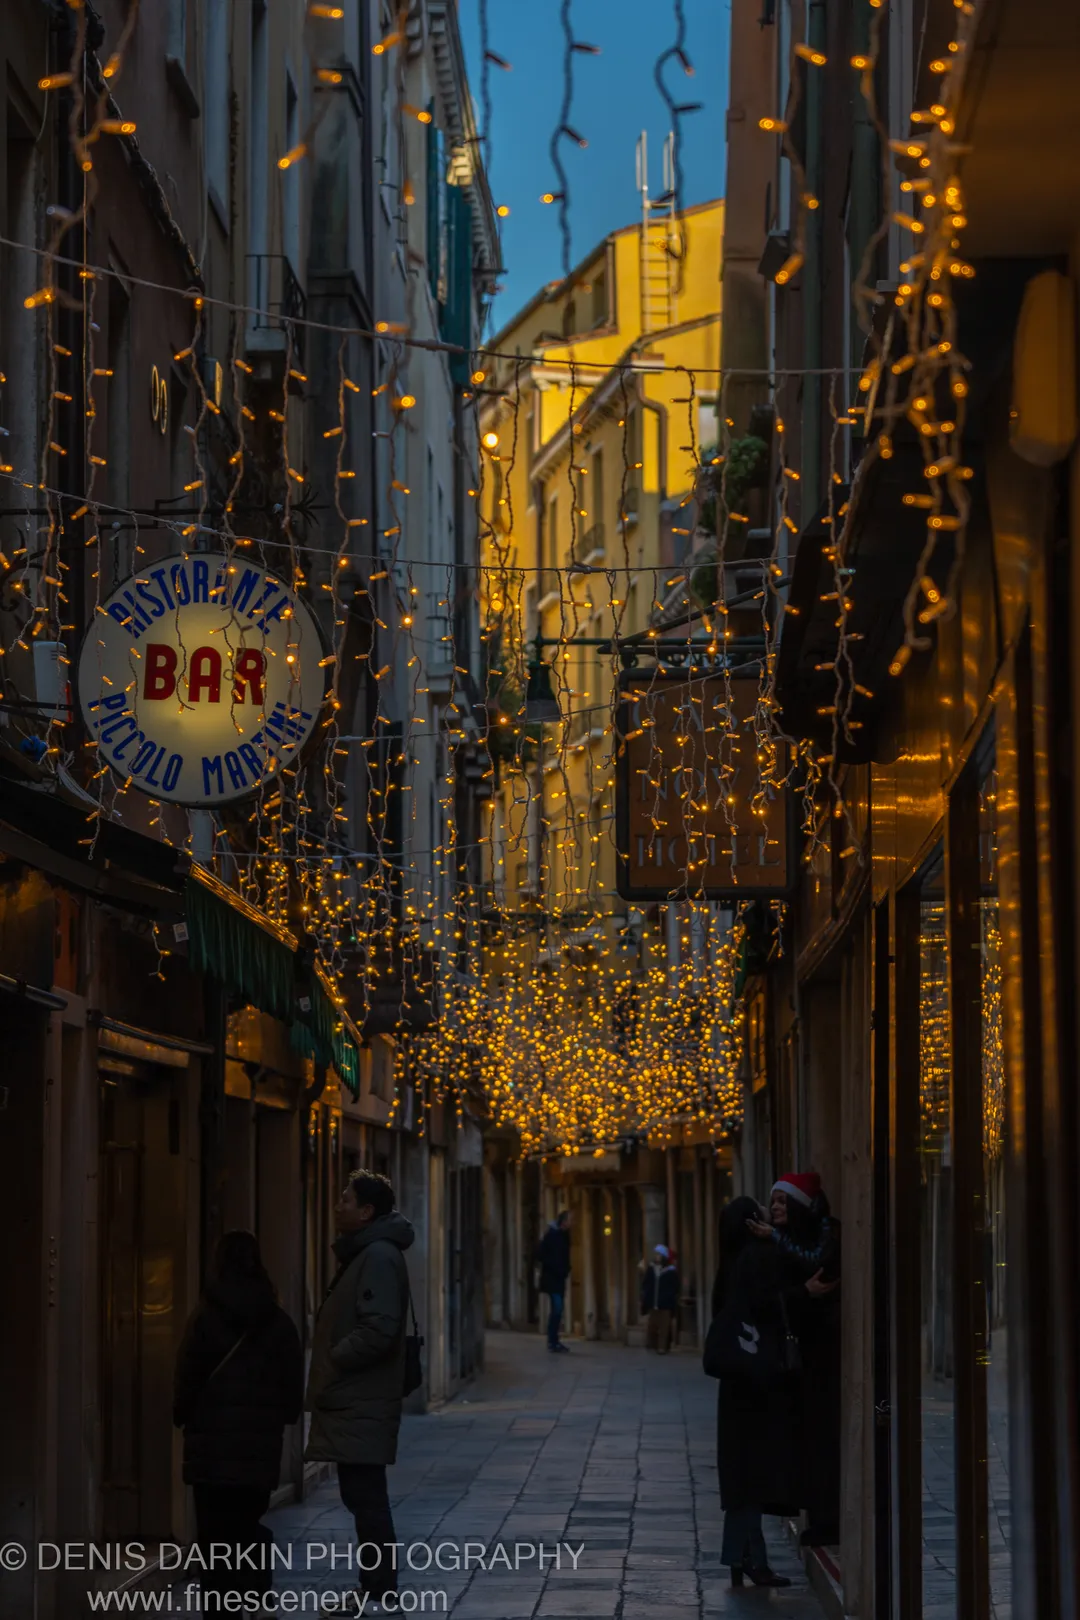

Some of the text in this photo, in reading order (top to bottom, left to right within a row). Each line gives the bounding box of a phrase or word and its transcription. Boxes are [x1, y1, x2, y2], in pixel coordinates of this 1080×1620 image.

[107, 560, 294, 638] RISTORANTE
[143, 643, 267, 706] BAR
[632, 690, 774, 732] CAS
[88, 692, 312, 795] PICCOLO MARTINI
[634, 833, 781, 867] HOTEL
